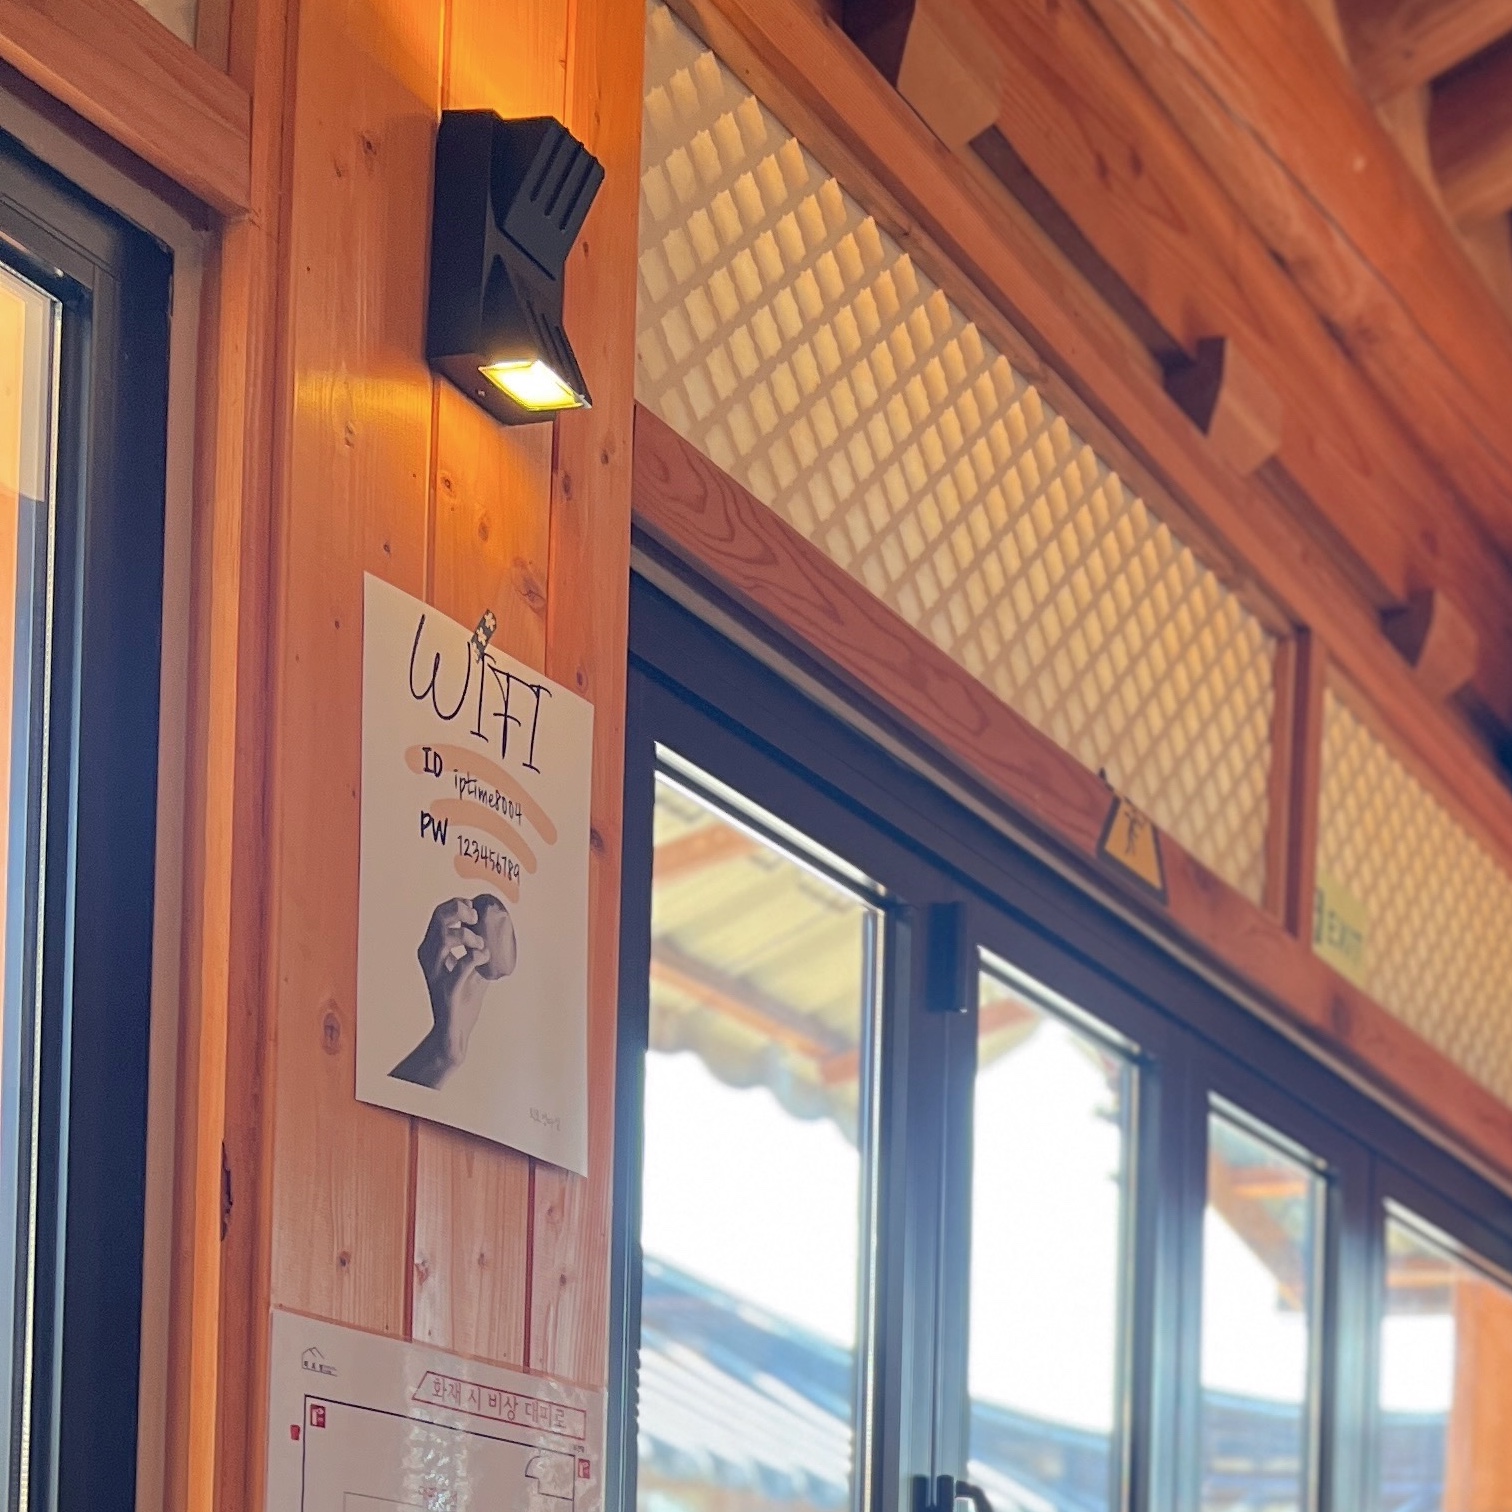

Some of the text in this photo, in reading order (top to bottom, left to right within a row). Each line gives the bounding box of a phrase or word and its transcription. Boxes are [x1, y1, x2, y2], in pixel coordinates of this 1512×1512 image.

[409, 613, 552, 773] WIFI
[422, 747, 522, 826] ID iptime8004
[420, 810, 520, 886] PW 123456789
[432, 1377, 566, 1430] 화재 시 비상 대피로
